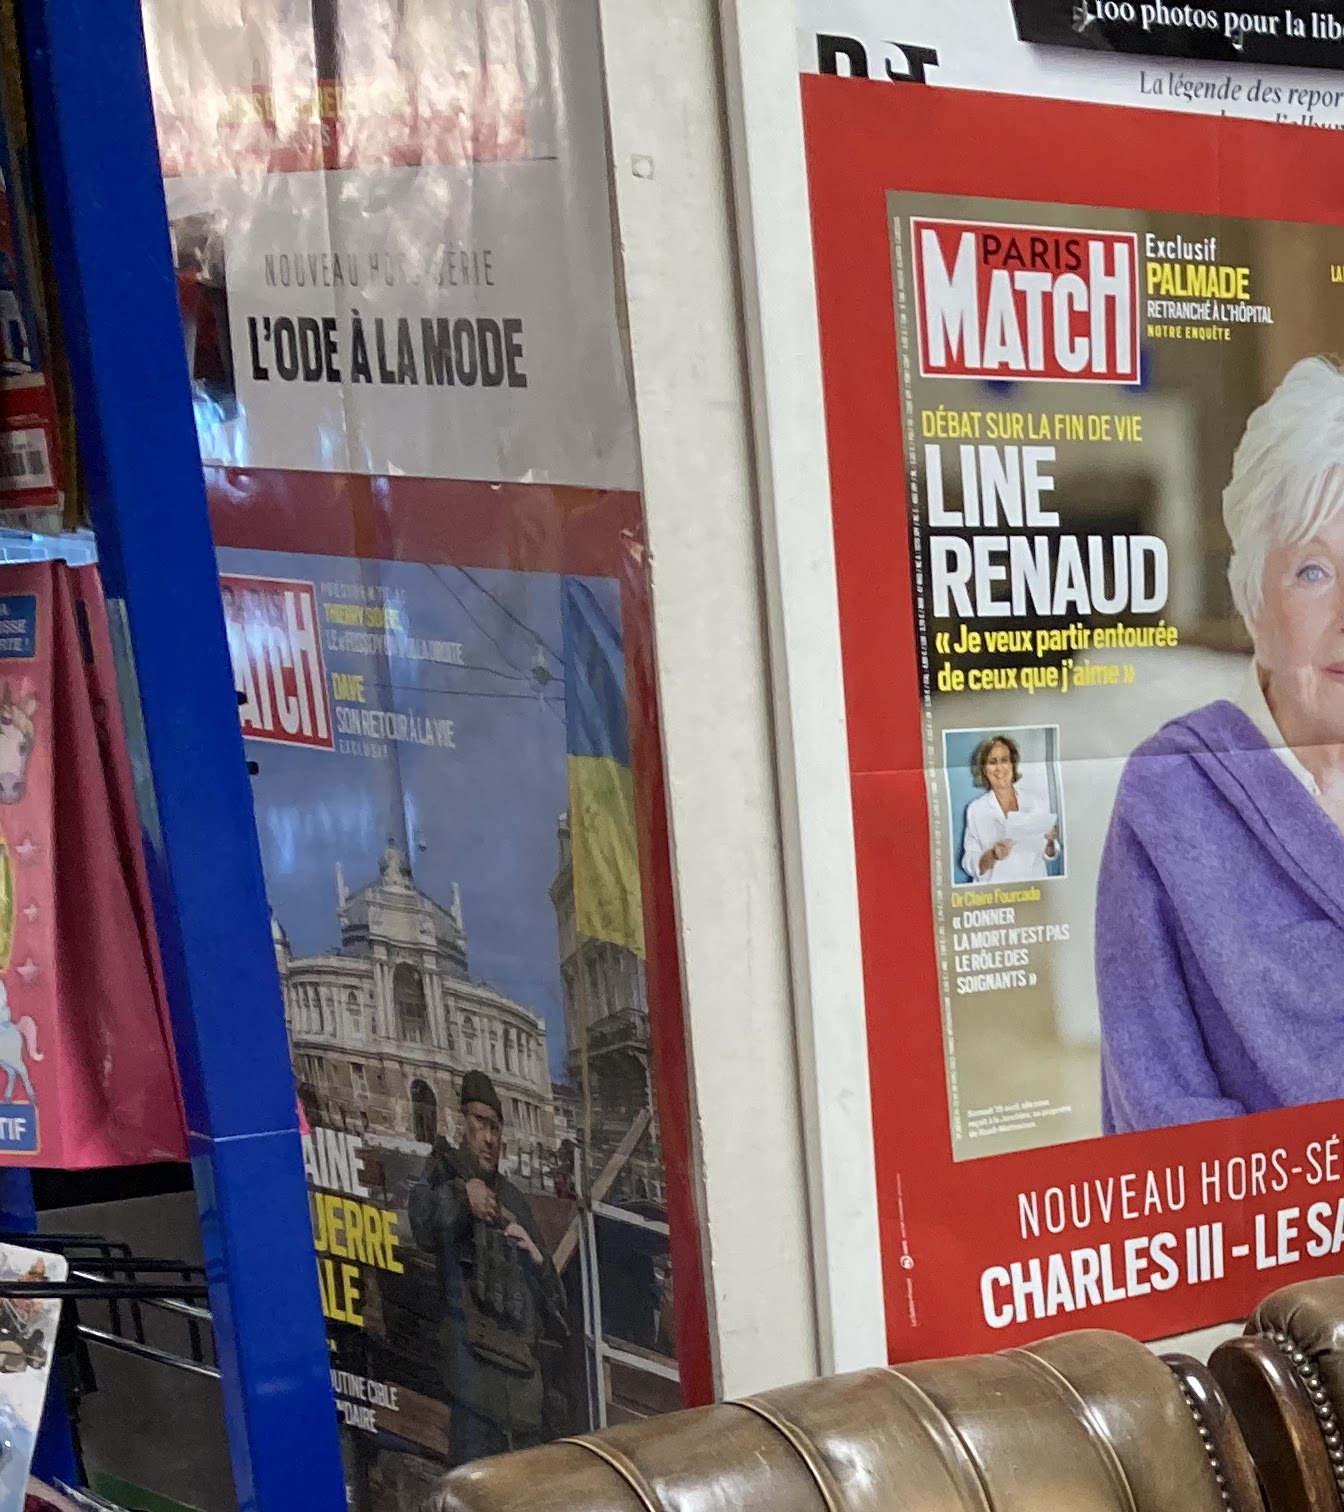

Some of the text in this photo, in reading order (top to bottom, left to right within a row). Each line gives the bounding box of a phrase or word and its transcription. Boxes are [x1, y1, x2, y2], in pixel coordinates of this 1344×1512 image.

[1142, 3, 1218, 31] photos
[1224, 12, 1280, 38] pour
[1285, 10, 1306, 37] la
[1139, 70, 1163, 96] La
[1169, 72, 1242, 103] légende
[1250, 79, 1281, 104] des
[981, 233, 1082, 271] PARIS
[1146, 233, 1216, 262] Exclusif
[264, 252, 359, 287] NOUVEAU
[1147, 262, 1250, 299] PALMADE
[920, 229, 1131, 374] MATCH
[1147, 299, 1211, 321] RETRANCHÉ
[247, 308, 528, 387] L'ODE À LA MODE
[1147, 324, 1182, 339] NOTRE
[922, 405, 1143, 441] DÉBAT SUR LA FIN DE VIE
[924, 443, 1060, 528] LINE
[930, 535, 1169, 617] RENAUD
[953, 620, 1178, 657] Je veux partir entourée
[937, 662, 1058, 694] de ceux que
[963, 907, 1016, 928] DONNER
[953, 924, 1070, 951] LA MORT N'EST PAS
[955, 949, 1029, 973] LE RÔLE DES
[957, 970, 1027, 995] SOIGNANTS
[1017, 1165, 1186, 1240] NOUVEAU
[979, 1231, 1179, 1329] CHARLES
[1185, 1221, 1224, 1285] III
[1254, 1207, 1300, 1271] LE
